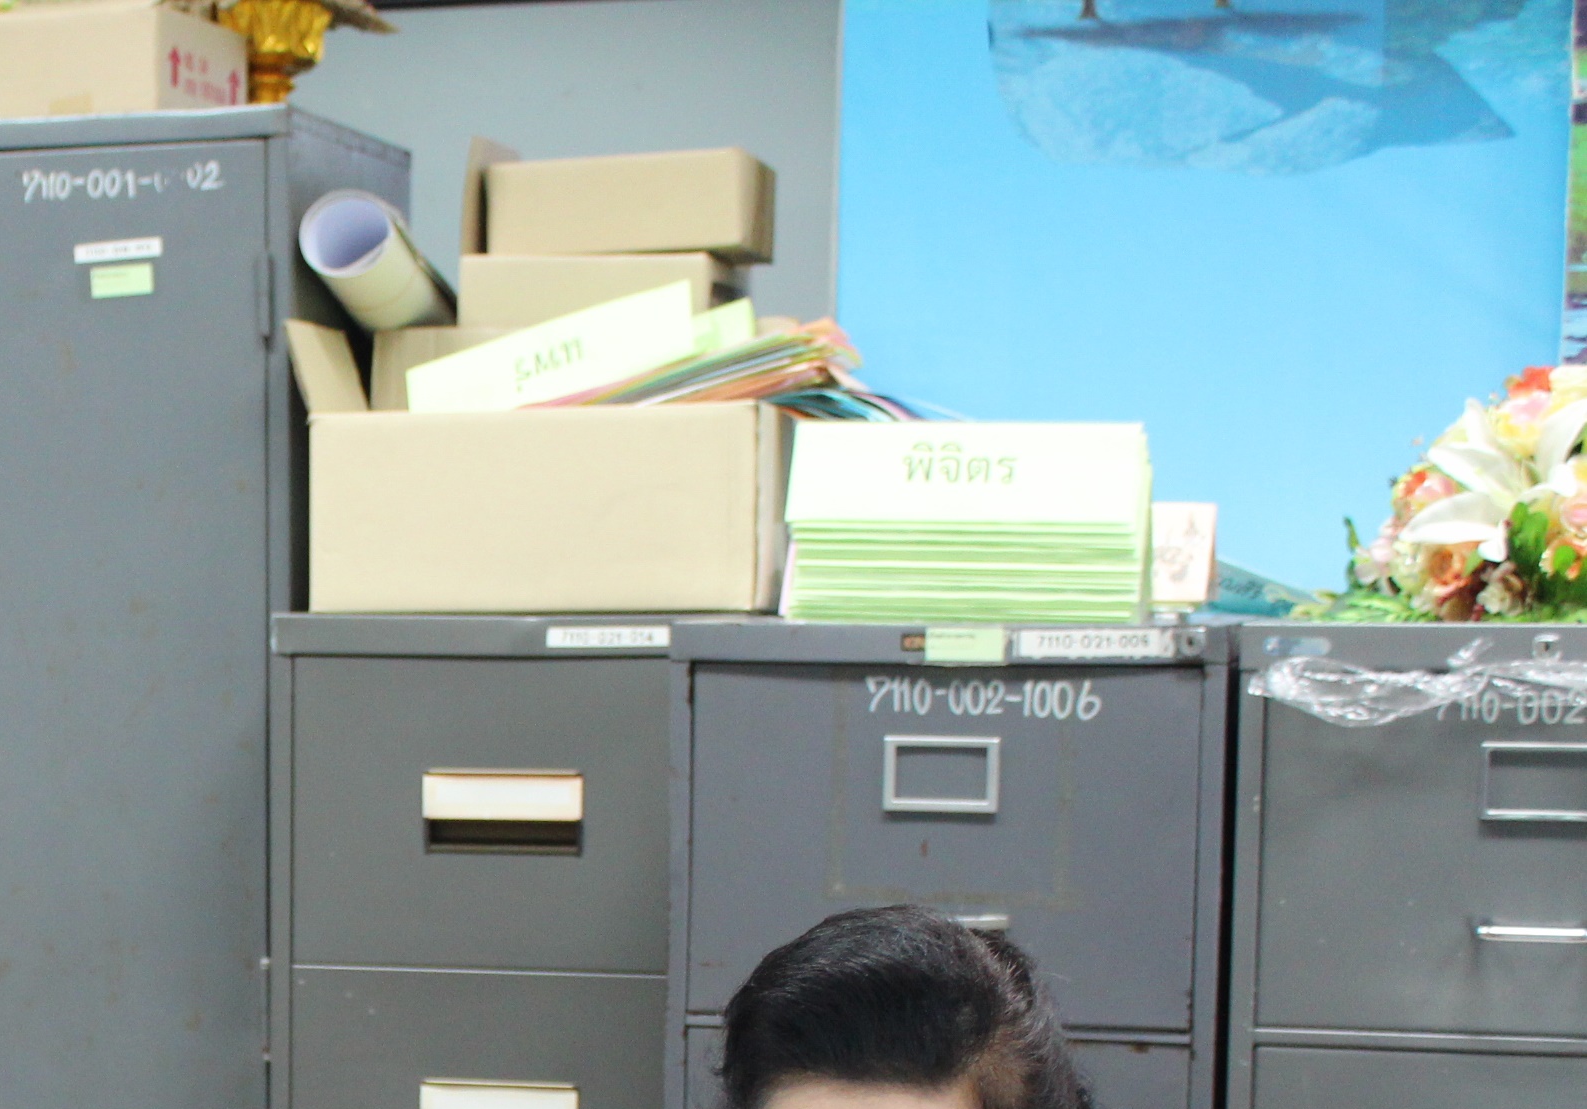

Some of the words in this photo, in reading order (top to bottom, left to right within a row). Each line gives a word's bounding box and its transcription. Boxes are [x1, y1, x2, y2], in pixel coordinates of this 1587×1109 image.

[903, 441, 1018, 485] พิจิตร
[866, 676, 1103, 721] 7110-002-1006
